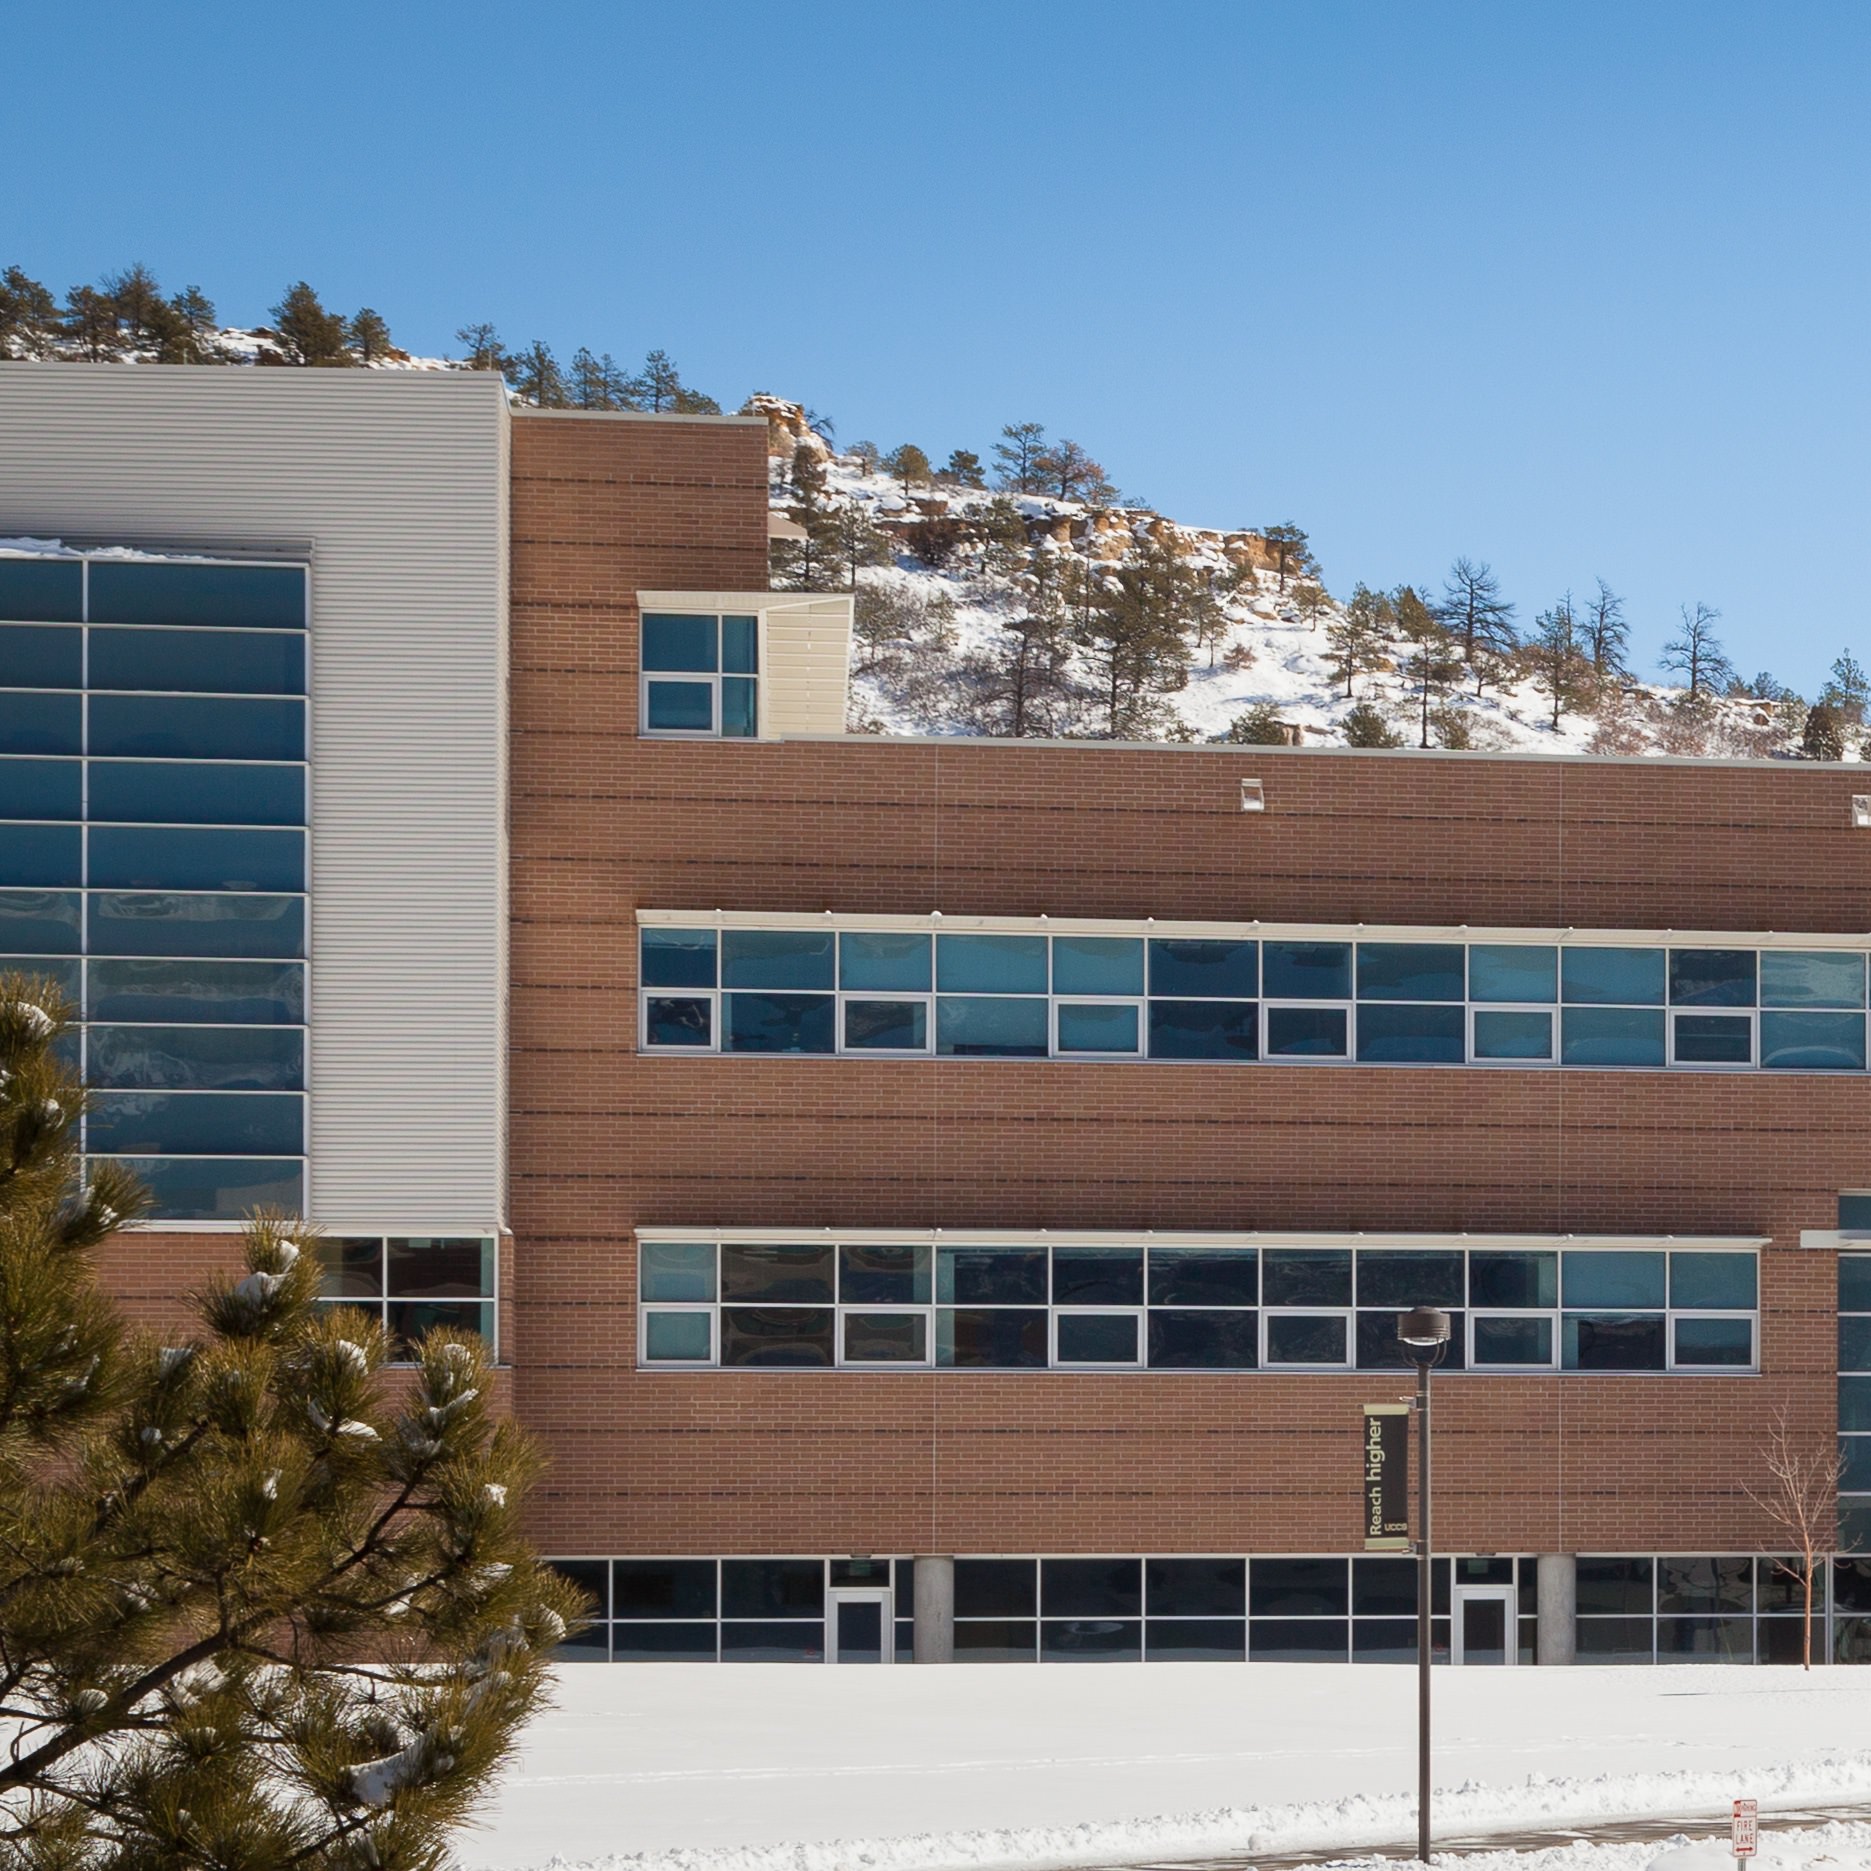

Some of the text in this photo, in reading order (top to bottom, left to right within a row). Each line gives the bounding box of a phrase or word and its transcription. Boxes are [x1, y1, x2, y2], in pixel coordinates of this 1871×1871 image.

[1366, 1417, 1385, 1535] Reach higher
[1384, 1523, 1408, 1532] UCCS
[1737, 1820, 1753, 1831] FIRE
[1736, 1833, 1753, 1845] LANE
